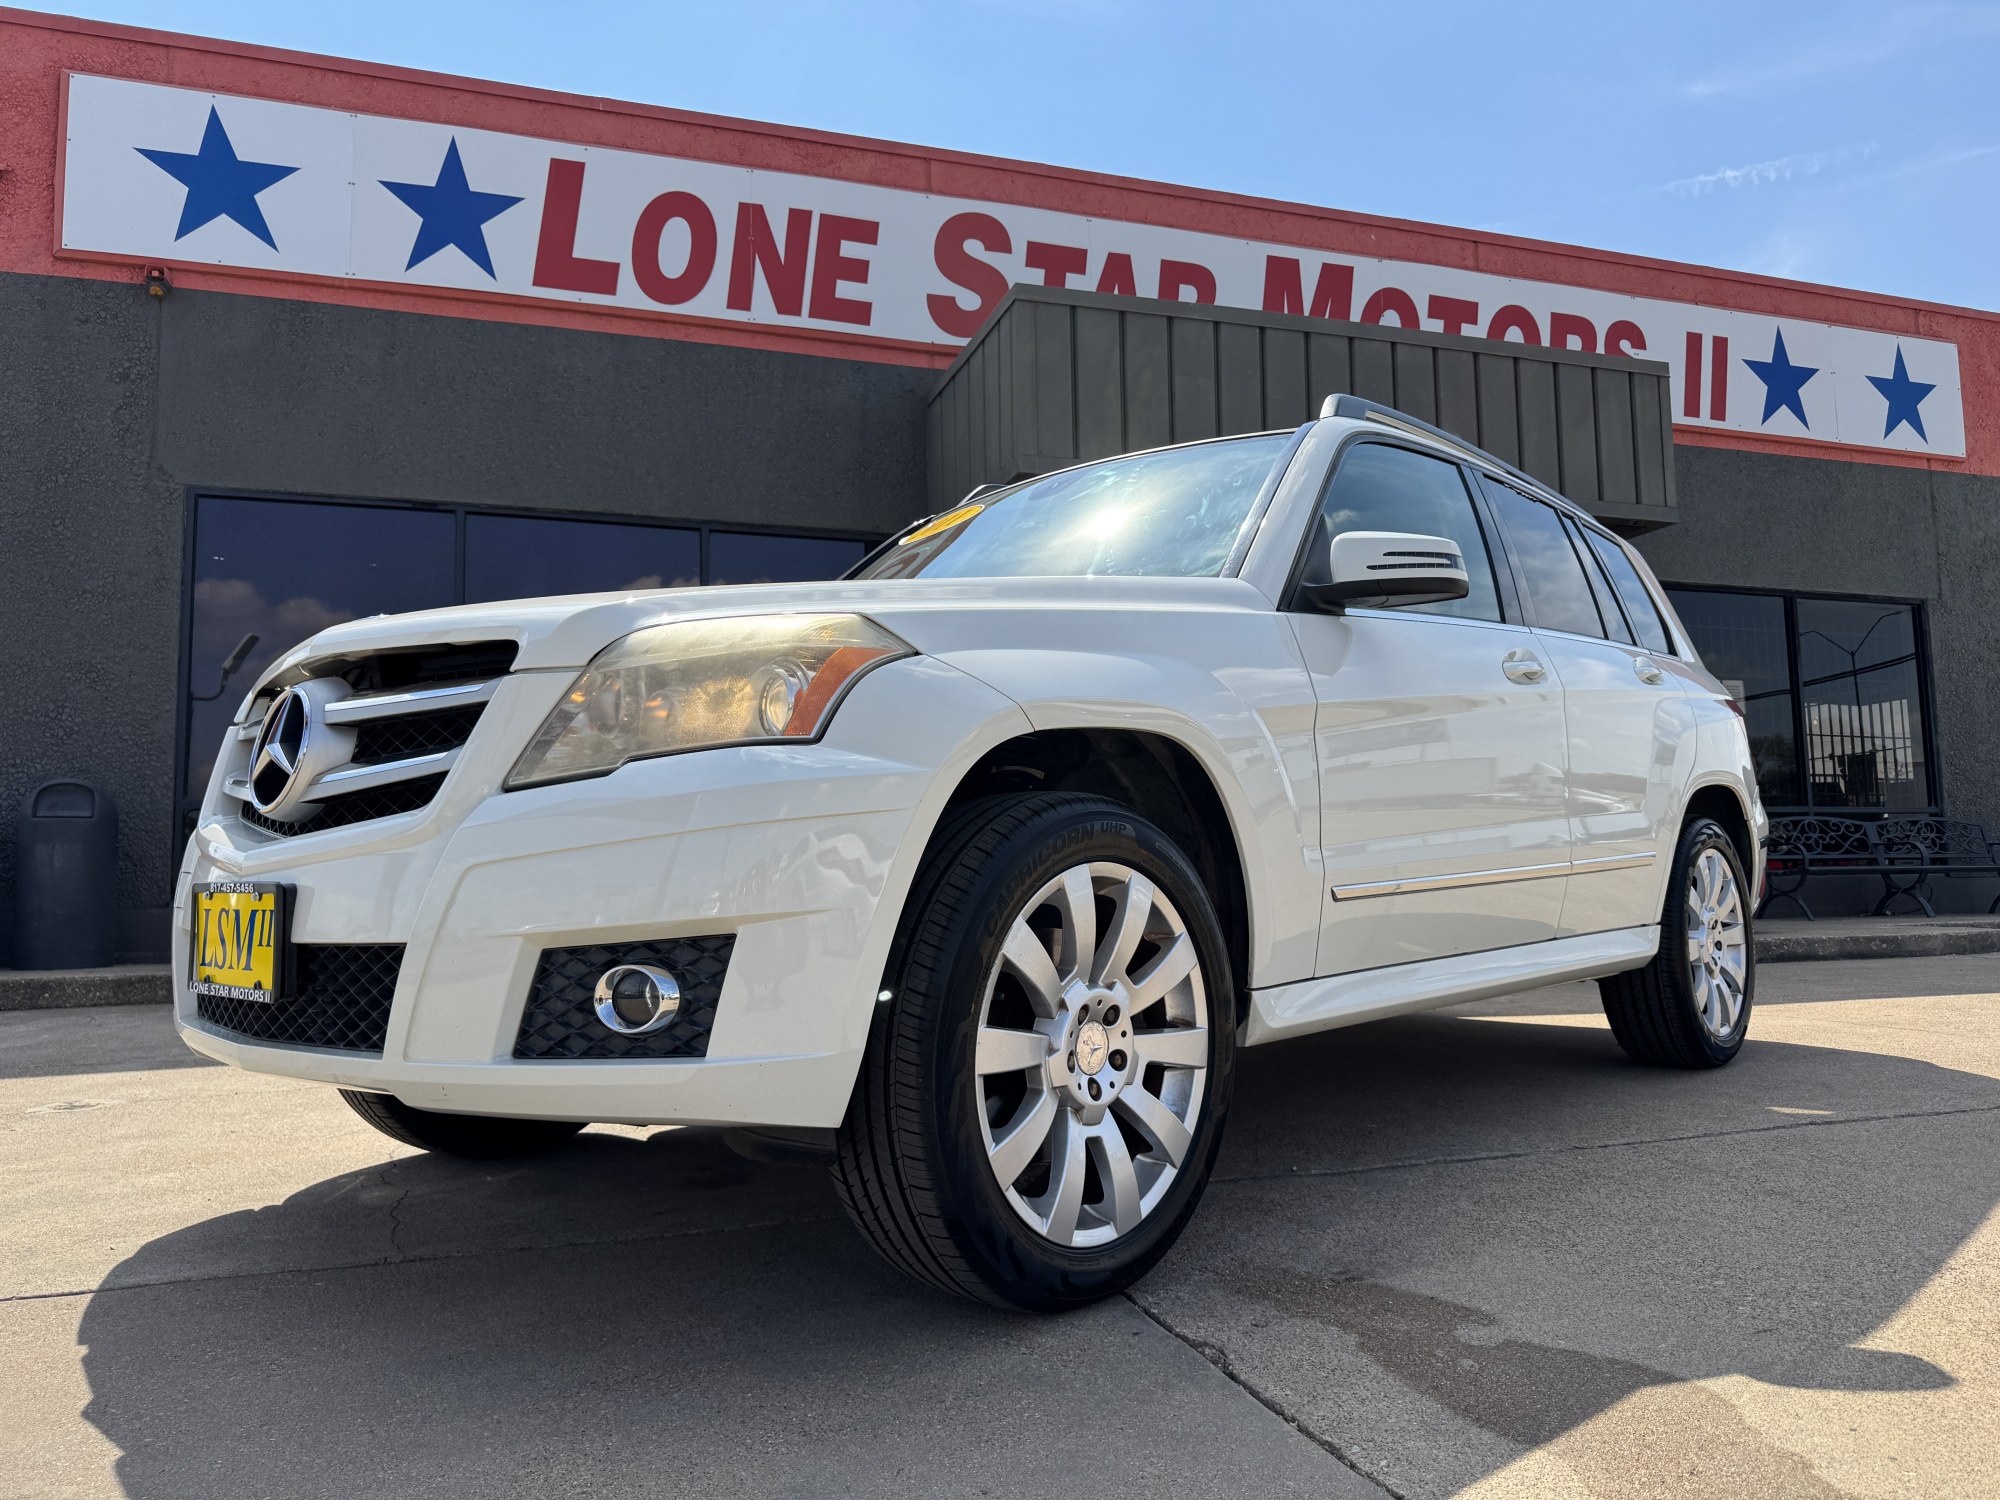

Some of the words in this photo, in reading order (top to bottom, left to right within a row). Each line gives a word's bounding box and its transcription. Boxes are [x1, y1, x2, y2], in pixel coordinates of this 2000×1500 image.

[532, 157, 880, 327] LONE
[1684, 331, 1729, 422] II
[1100, 821, 1127, 834] UHP
[210, 883, 254, 892] 817-457-5456
[189, 981, 209, 994] LONE
[210, 984, 229, 997] STAR
[231, 987, 264, 1001] MOTORS
[265, 992, 271, 1002] II
